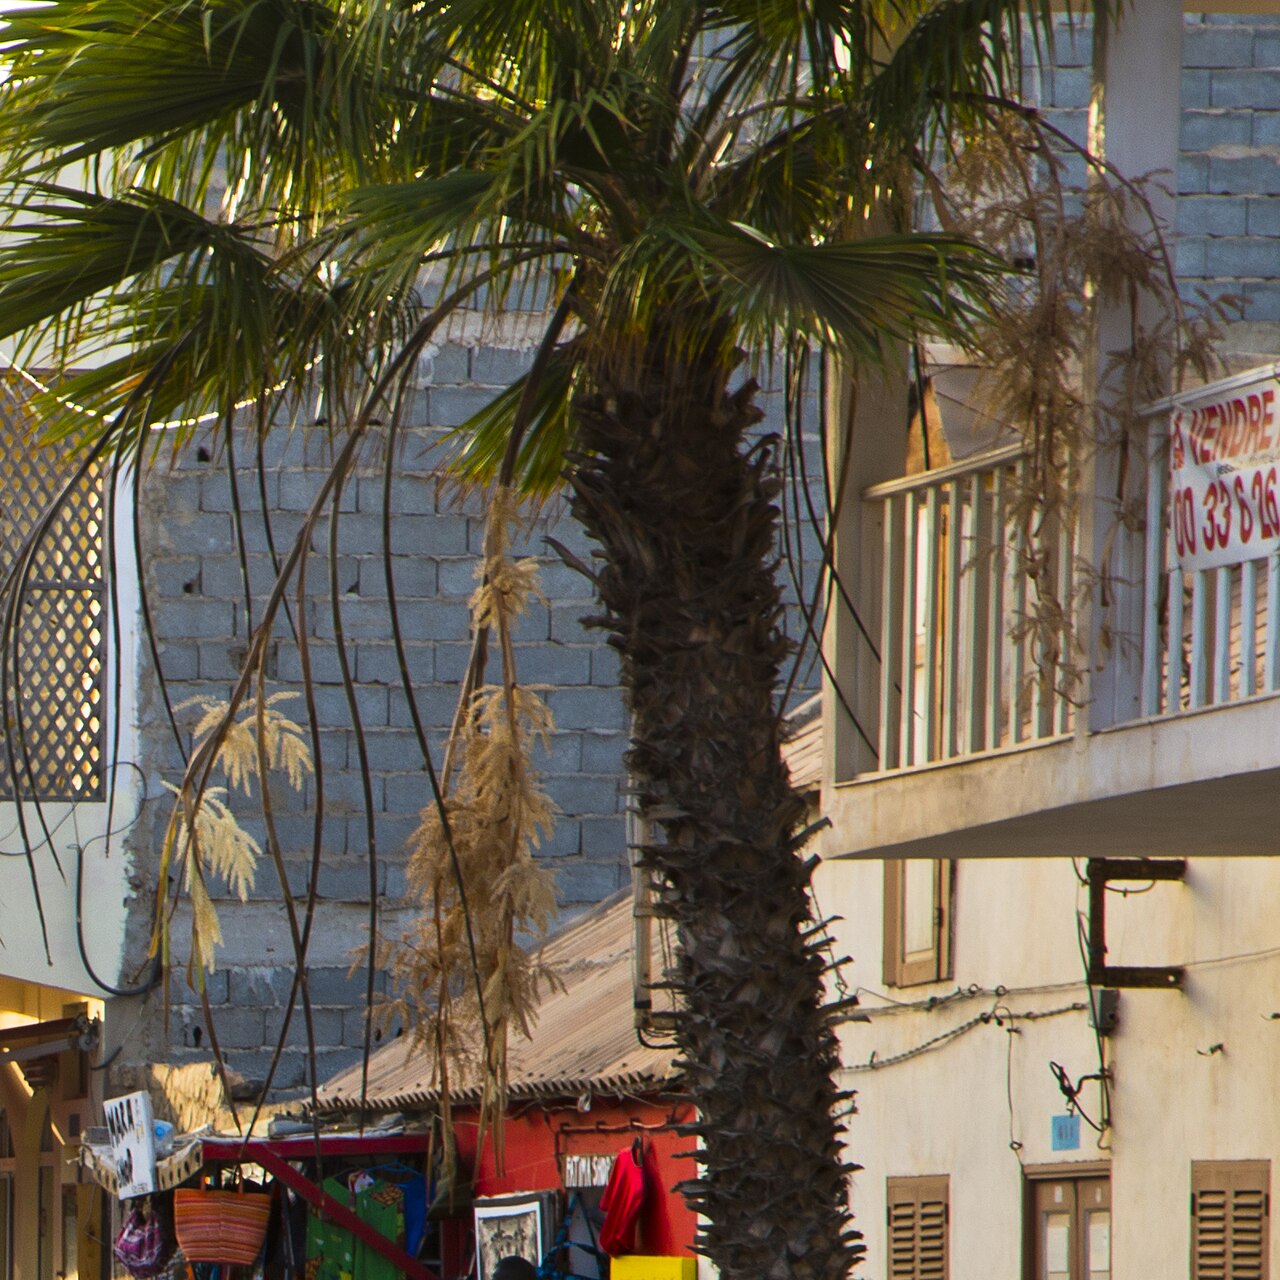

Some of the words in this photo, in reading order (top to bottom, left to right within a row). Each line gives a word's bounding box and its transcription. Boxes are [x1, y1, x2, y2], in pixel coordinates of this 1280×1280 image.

[1189, 390, 1274, 466] VENDRE
[1174, 486, 1196, 557] 00
[1202, 481, 1233, 551] 33
[1234, 475, 1253, 544] 6
